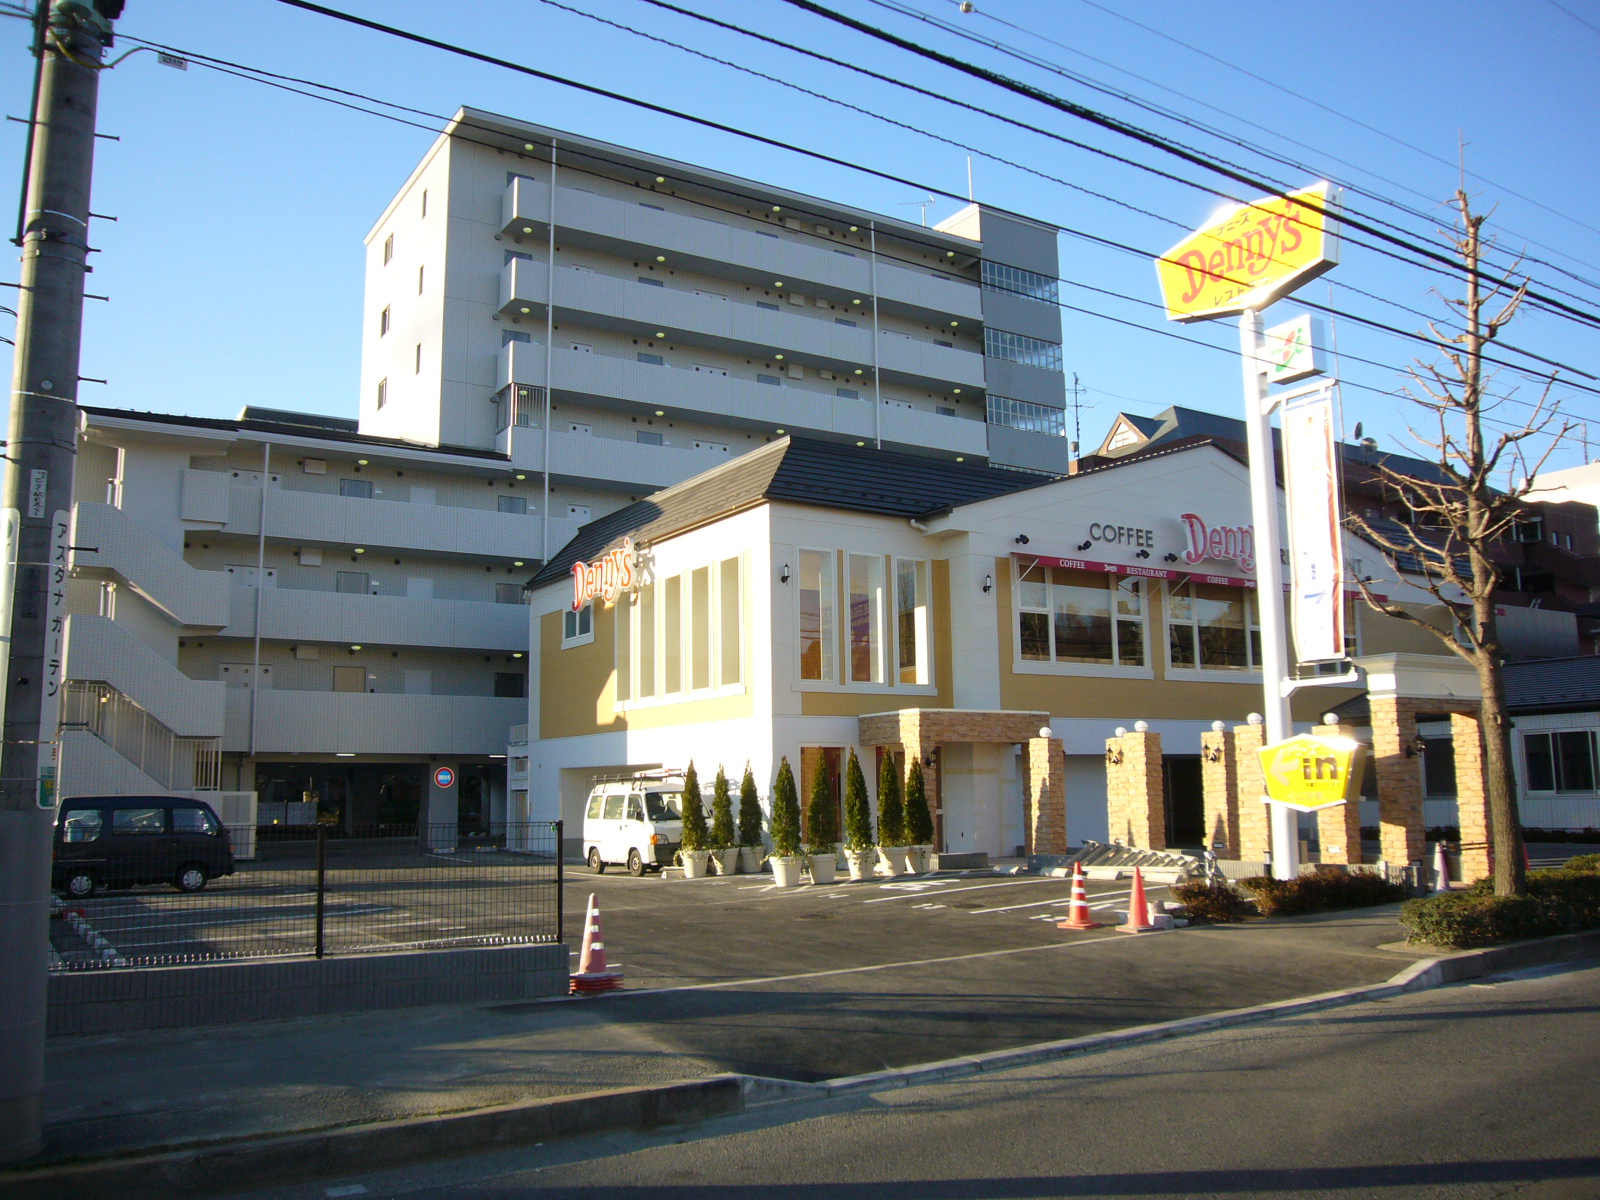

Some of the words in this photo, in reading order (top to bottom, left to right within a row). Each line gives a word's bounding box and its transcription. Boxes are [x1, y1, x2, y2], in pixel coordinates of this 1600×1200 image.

[1175, 199, 1303, 304] Denny's
[1089, 522, 1154, 549] COFFEE
[571, 537, 632, 612] Denny's
[1059, 559, 1086, 569] COFFEE
[1126, 566, 1168, 578] RESTAURANT
[1207, 575, 1230, 585] COFFEE
[48, 522, 68, 698] アスタナガーデン
[1302, 757, 1338, 780] in
